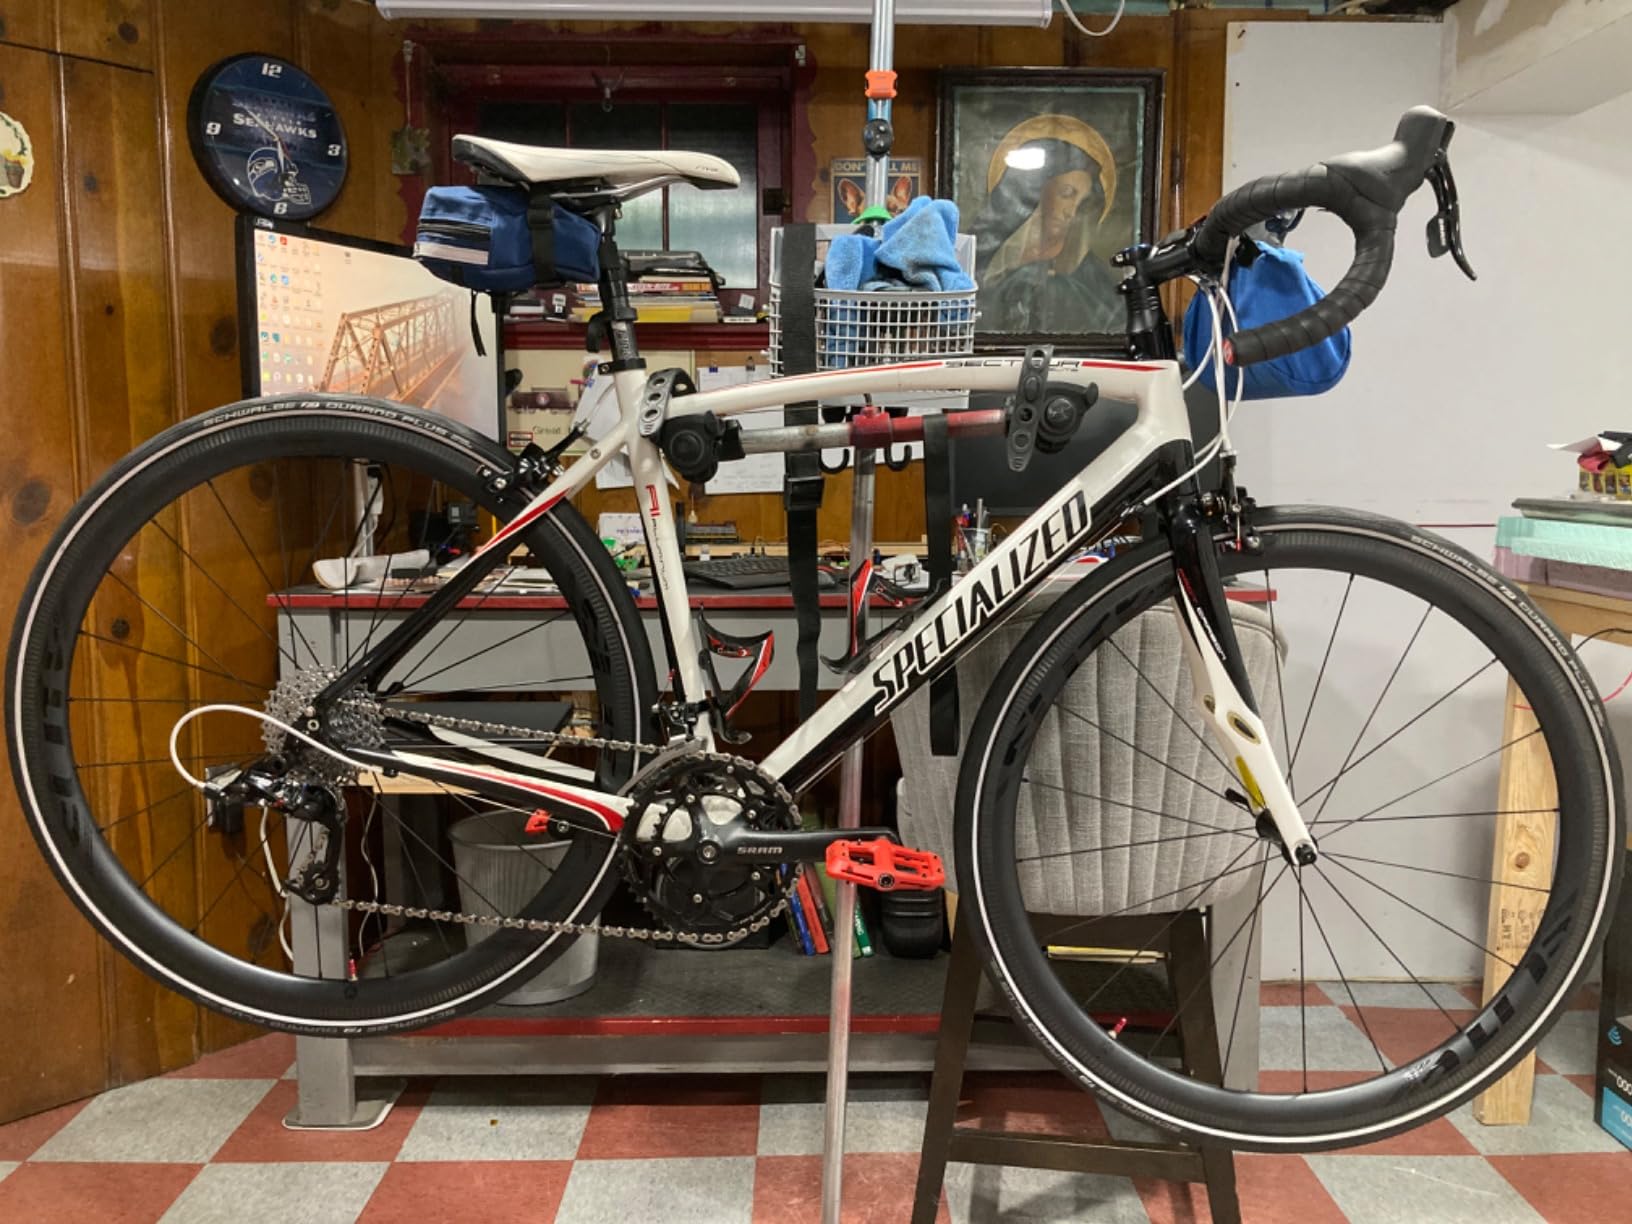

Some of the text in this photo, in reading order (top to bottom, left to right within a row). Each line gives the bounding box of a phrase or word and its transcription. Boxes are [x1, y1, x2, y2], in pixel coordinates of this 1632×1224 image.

[261, 62, 283, 78] 12
[327, 143, 341, 156] 3
[203, 401, 449, 436] SCHWALBE DURANO PLUS
[1411, 535, 1499, 585] SCHWALBE
[872, 489, 1090, 712] SPECIALIZED
[736, 846, 783, 855] SRAM
